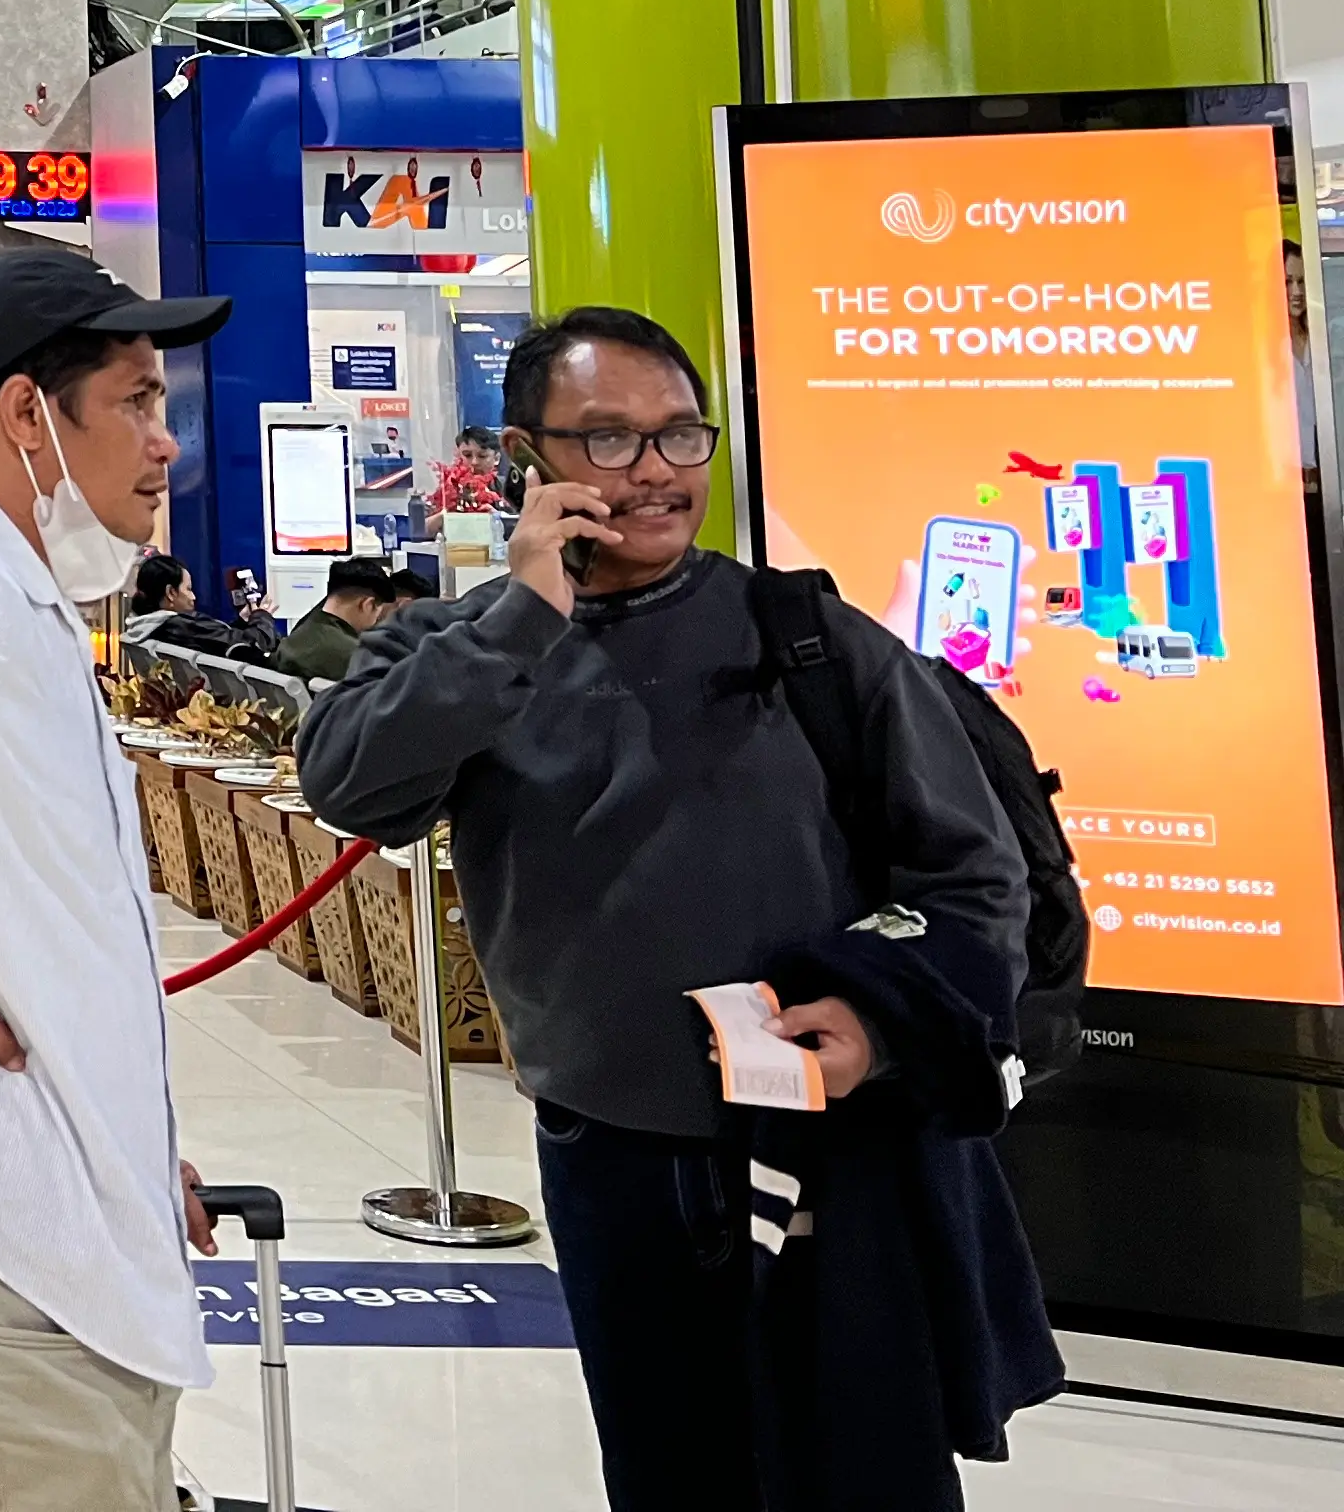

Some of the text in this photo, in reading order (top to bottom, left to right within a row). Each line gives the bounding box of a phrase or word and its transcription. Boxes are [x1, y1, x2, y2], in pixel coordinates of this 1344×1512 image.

[27, 154, 87, 201] 39
[322, 173, 451, 229] KAI
[965, 198, 1127, 234] cityvision
[812, 281, 1212, 314] THE OUT-OF-HOME
[377, 323, 396, 331] KAI
[834, 324, 1199, 356] FOR TOMORROW
[923, 378, 946, 388] and
[949, 378, 980, 388] most
[1086, 377, 1159, 390] advertising
[375, 402, 407, 412] LOKET
[952, 542, 991, 553] MARKET
[953, 531, 975, 541] CITY
[1122, 819, 1206, 838] YOURS
[1103, 872, 1275, 896] +62 21 5290 5652
[1133, 912, 1281, 936] cityvision.co.id
